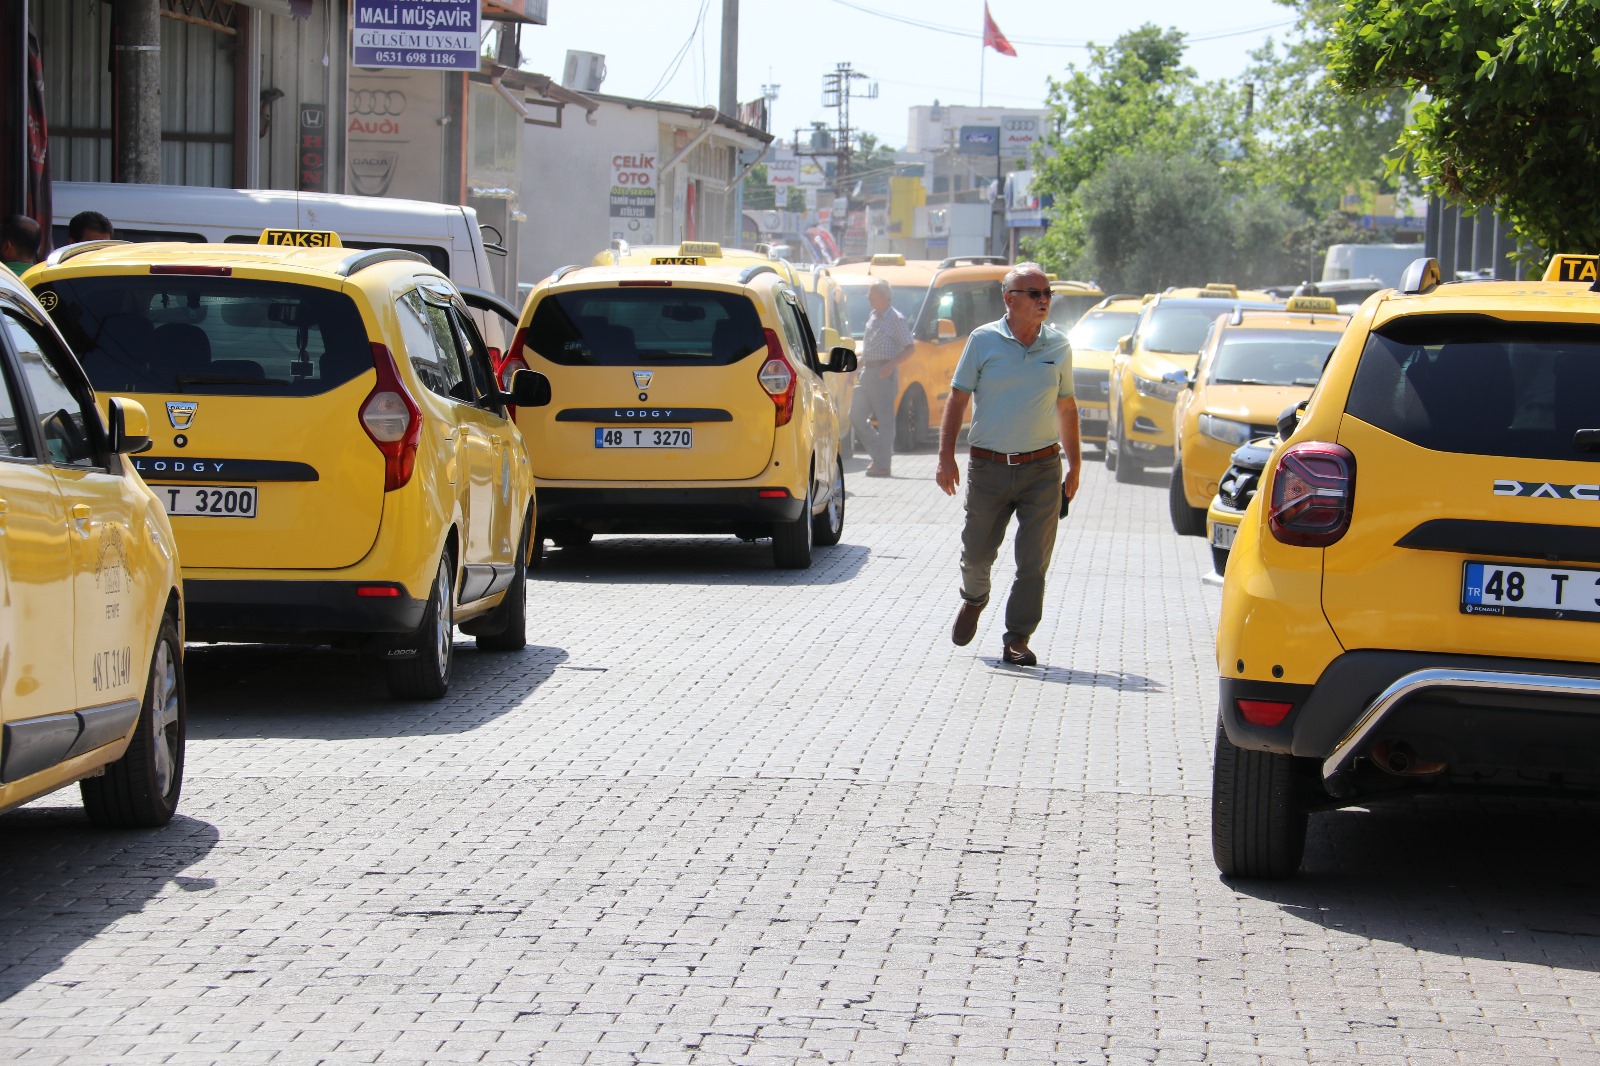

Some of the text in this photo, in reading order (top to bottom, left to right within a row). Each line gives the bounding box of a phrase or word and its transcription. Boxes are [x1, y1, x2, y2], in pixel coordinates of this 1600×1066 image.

[360, 5, 472, 29] MALİ MÜŞAVİR
[360, 31, 472, 49] GÜLSÜM UYSAL
[375, 51, 456, 64] 0531 698 1186
[348, 118, 399, 134] Audi
[303, 135, 323, 192] HON
[353, 158, 389, 166] DACIA
[612, 153, 656, 171] ÇELİK
[617, 172, 651, 185] OTO
[1563, 259, 1598, 280] TA
[40, 297, 55, 307] 53
[604, 430, 691, 446] 48 T 3270
[136, 461, 224, 472] LODGY
[1493, 479, 1600, 500] DAC
[167, 489, 253, 514] T 3200
[1468, 587, 1481, 597] TR
[1485, 570, 1525, 602] 48
[1551, 574, 1569, 604] T
[93, 646, 131, 692] 48 T 3140
